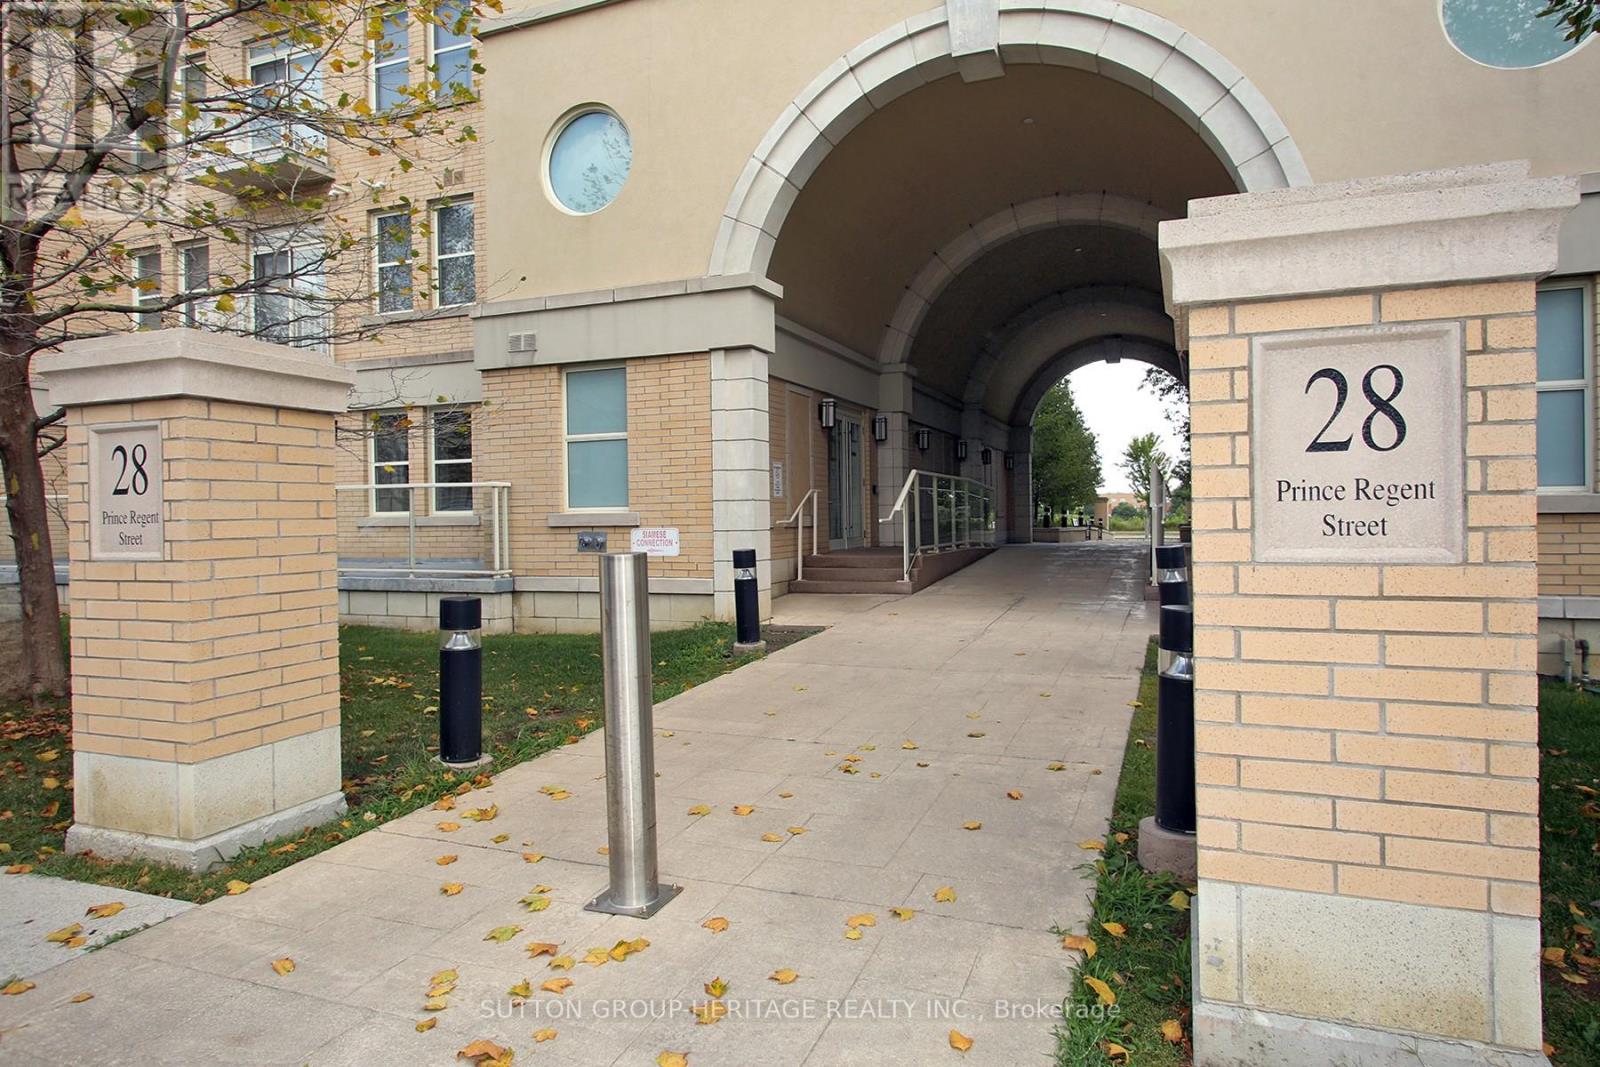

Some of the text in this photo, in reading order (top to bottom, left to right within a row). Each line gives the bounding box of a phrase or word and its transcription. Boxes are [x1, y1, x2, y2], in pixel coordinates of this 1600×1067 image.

[1304, 364, 1407, 452] 28
[111, 443, 149, 496] 28
[1277, 478, 1436, 506] Prince Regent
[102, 511, 159, 528] Prince Regent
[1322, 514, 1388, 537] Street
[119, 532, 143, 546] Street
[636, 539, 673, 547] CONNECTION
[642, 530, 667, 538] SIAMESE
